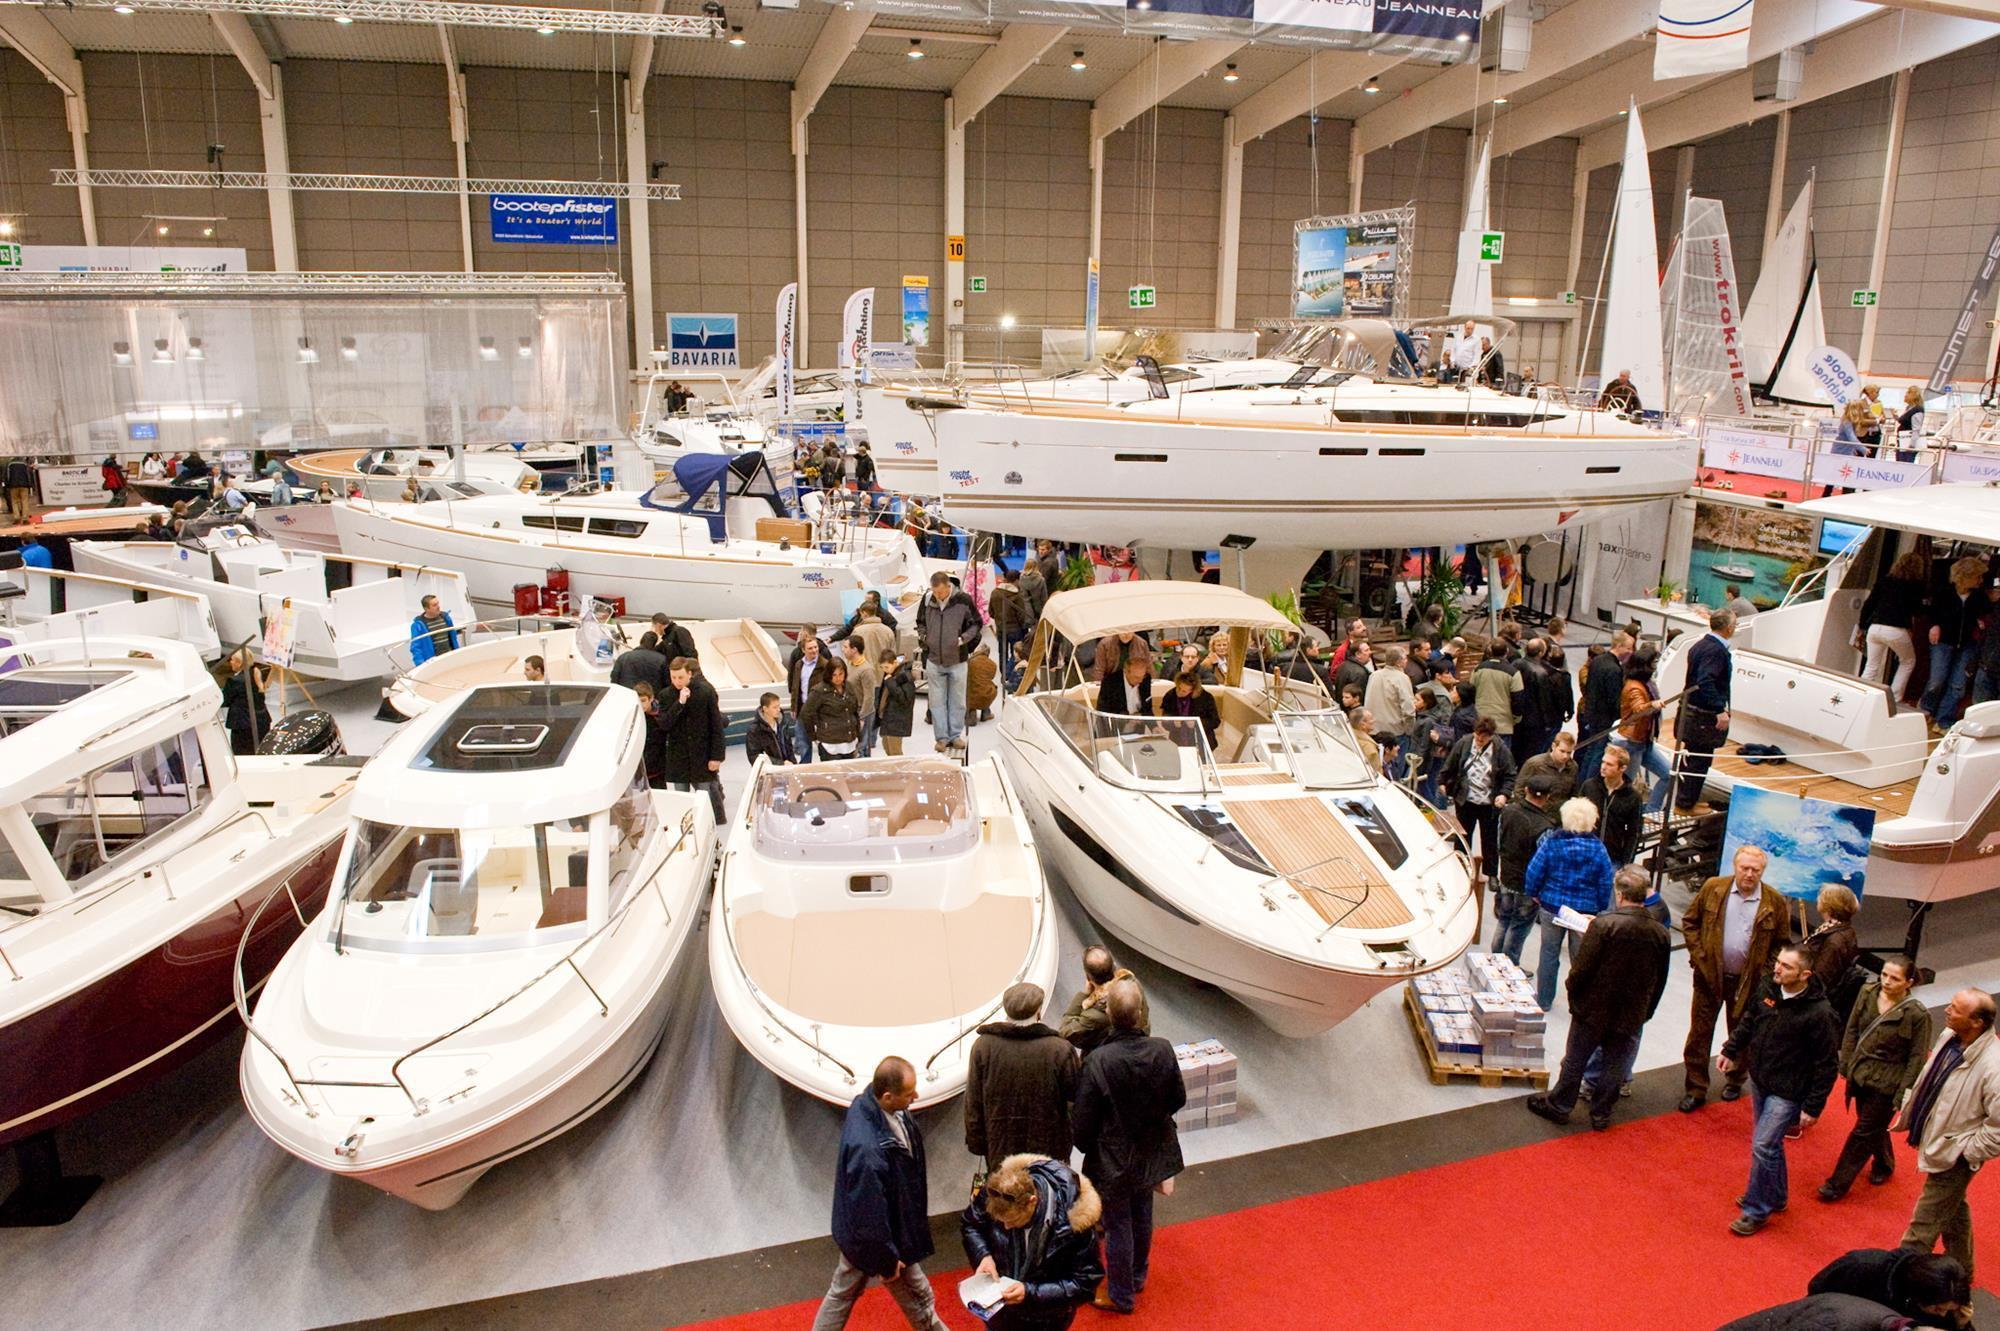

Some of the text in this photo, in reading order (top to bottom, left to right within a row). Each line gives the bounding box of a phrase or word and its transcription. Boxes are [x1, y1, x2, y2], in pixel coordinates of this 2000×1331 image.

[877, 0, 961, 11] www.jeanneau.com
[1377, 0, 1480, 19] JEANNEAU
[1018, 8, 1100, 20] www.jeanneau.com
[1152, 21, 1231, 33] www.jeanneau.com
[1278, 31, 1351, 45] www.jeanneau.com
[493, 197, 613, 215] bootepfister
[506, 216, 523, 224] It's
[536, 217, 571, 225] Boater's
[574, 217, 603, 226] World
[949, 243, 963, 256] 10
[1711, 238, 1746, 415] www.trokril.com
[1930, 289, 1979, 391] COMET
[671, 351, 737, 366] BAVARIA
[1742, 452, 1783, 468] JEANNEAU
[960, 477, 980, 488] TEST
[1856, 467, 1905, 484] JEANNEAU
[814, 578, 835, 588] TEST
